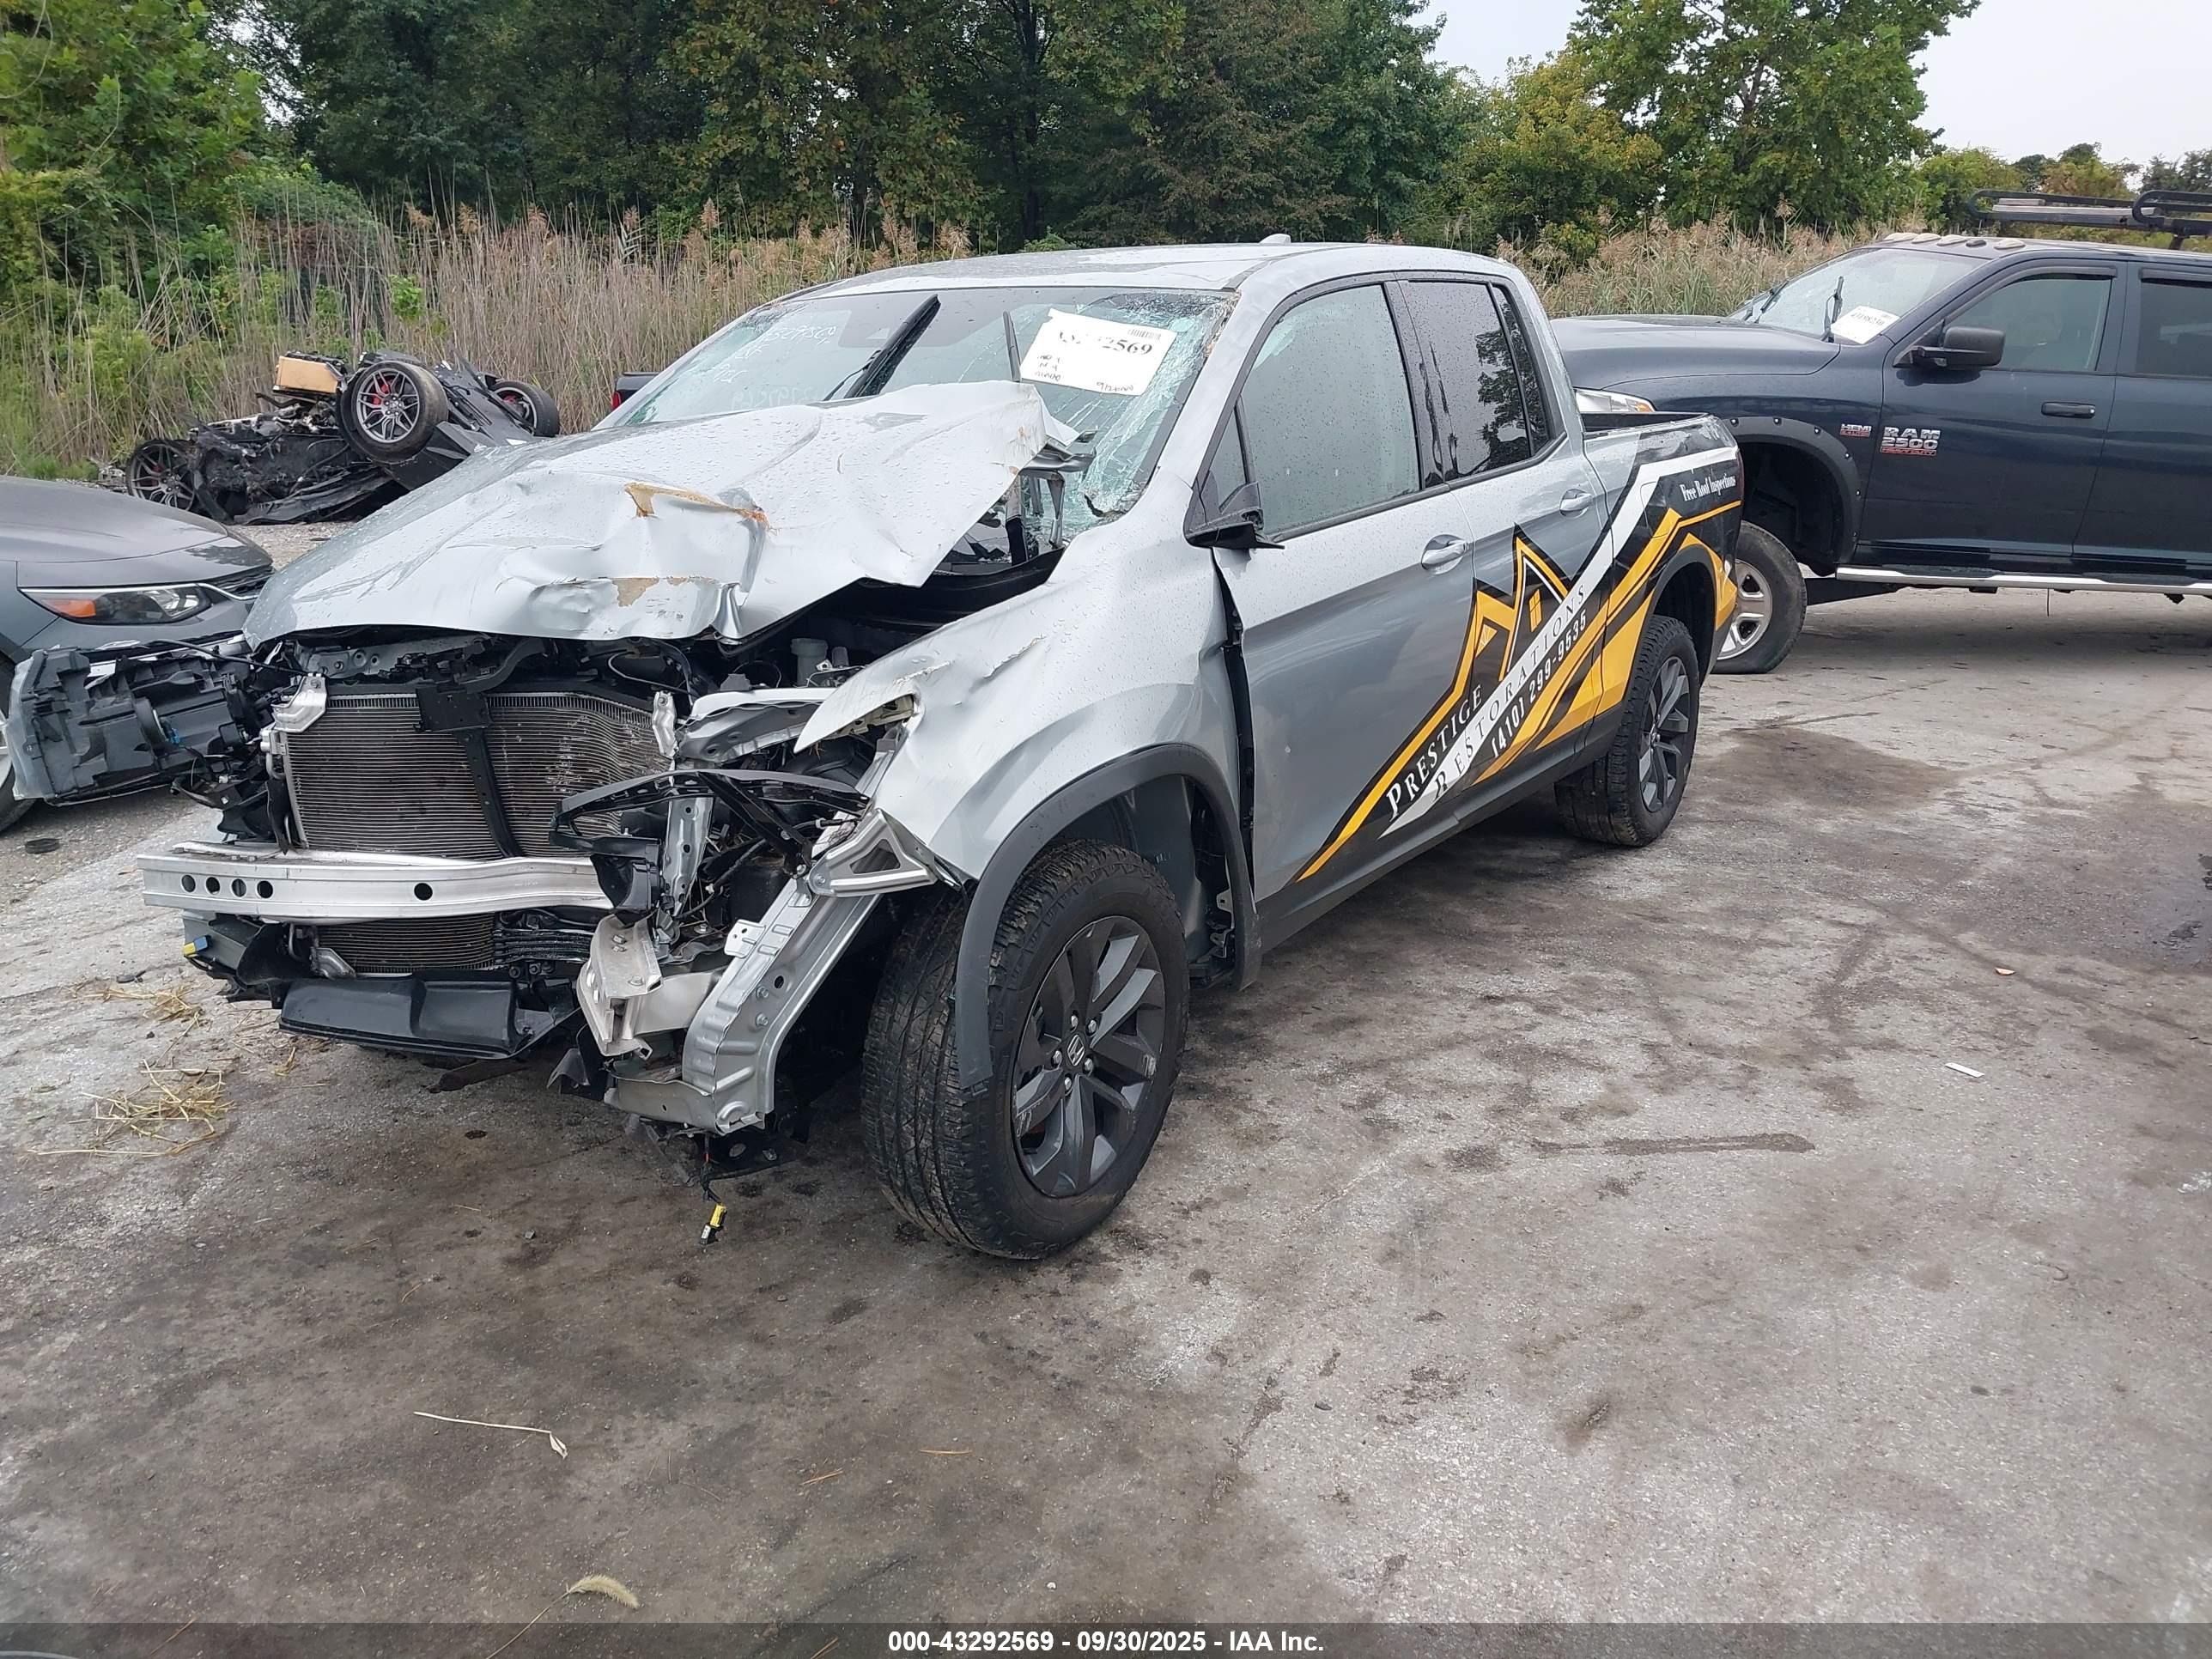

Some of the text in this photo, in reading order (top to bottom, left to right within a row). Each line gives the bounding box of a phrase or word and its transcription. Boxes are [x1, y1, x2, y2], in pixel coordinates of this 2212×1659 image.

[1881, 436, 1939, 450] 2500
[1883, 426, 1941, 440] RAM
[1680, 473, 1736, 501] Free Roof Inspections
[1528, 608, 1587, 705] 299-9535
[1431, 585, 1584, 803] RESTORATIONS
[1386, 685, 1482, 823] PRESTIGE
